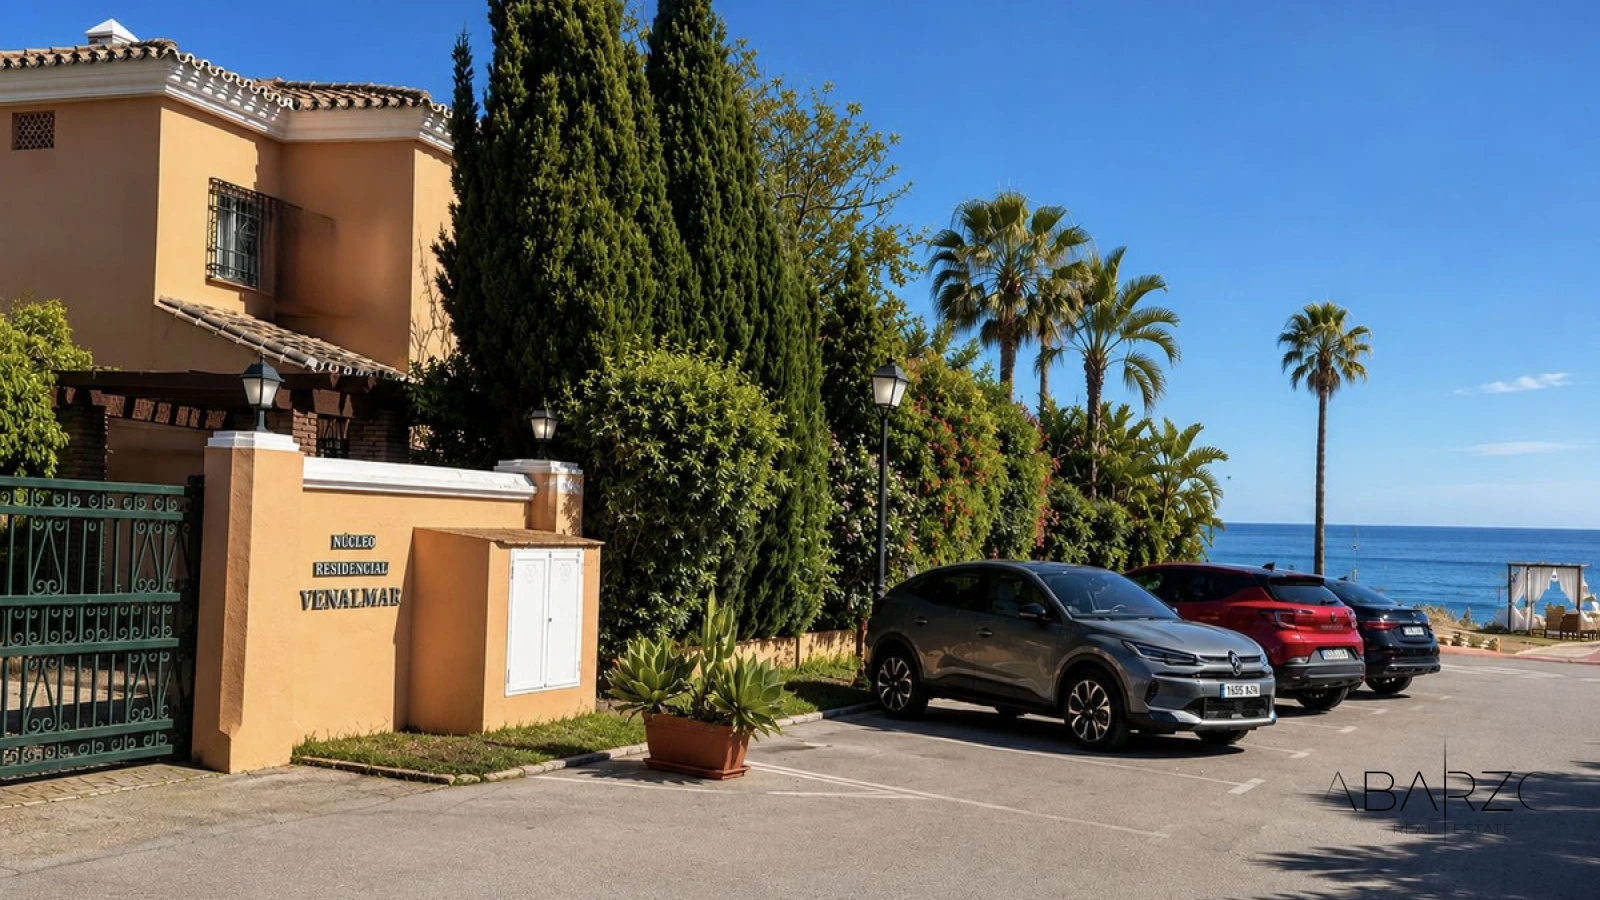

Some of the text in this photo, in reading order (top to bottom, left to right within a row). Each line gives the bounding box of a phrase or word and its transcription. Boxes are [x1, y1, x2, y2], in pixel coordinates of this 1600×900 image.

[331, 533, 376, 549] NÚCLEO
[313, 562, 388, 577] RESIDENCIAL
[300, 587, 401, 611] VENALMAR
